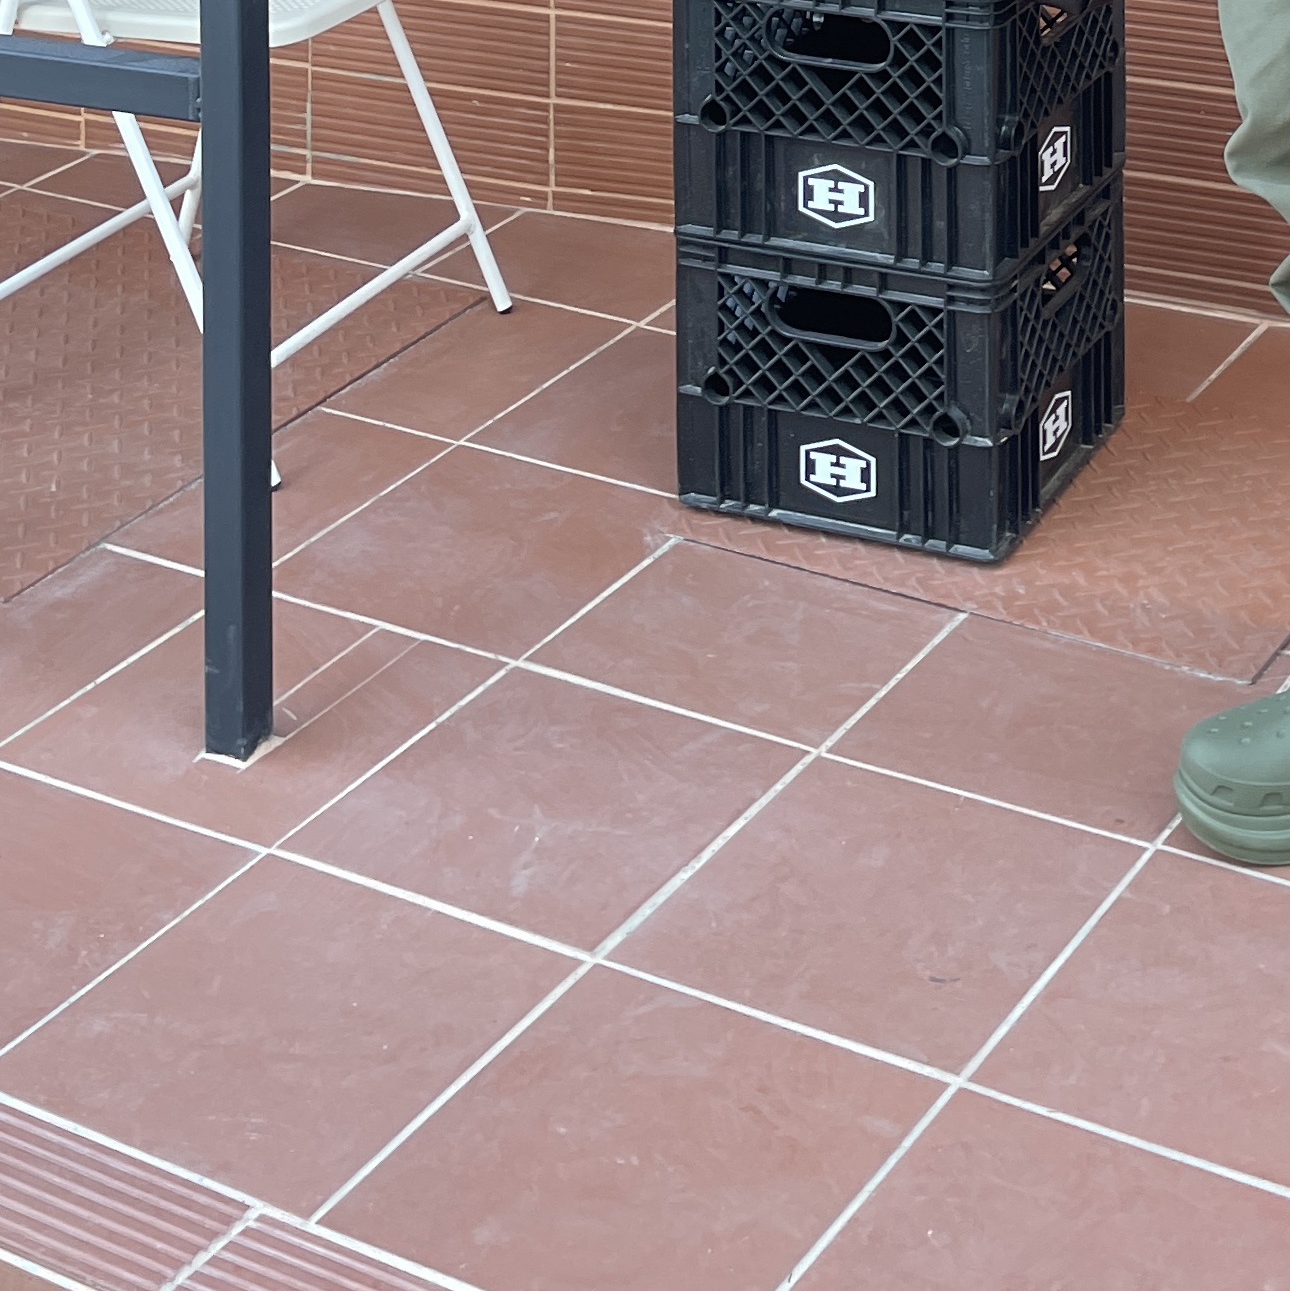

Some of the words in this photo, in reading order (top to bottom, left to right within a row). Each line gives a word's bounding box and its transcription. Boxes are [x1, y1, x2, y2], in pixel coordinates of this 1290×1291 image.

[1042, 134, 1066, 183] H
[807, 177, 865, 216] H
[1043, 399, 1068, 453] H
[809, 451, 867, 491] H
